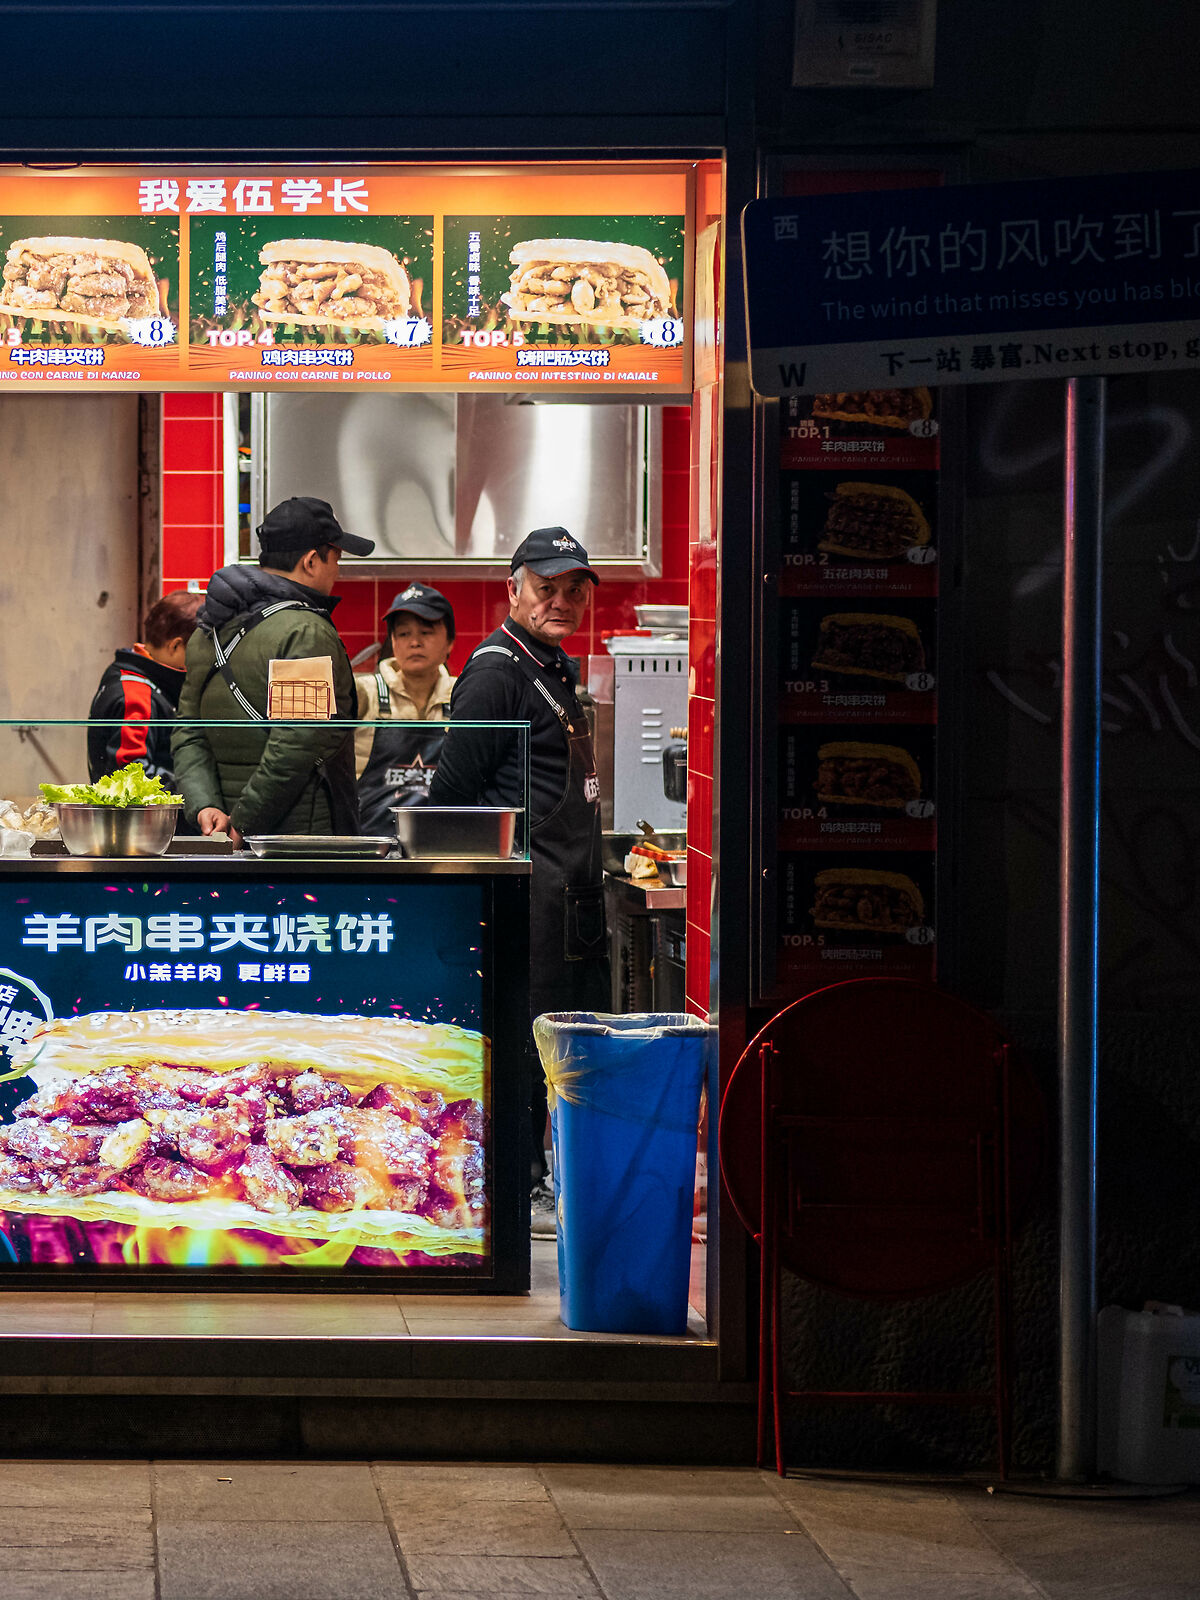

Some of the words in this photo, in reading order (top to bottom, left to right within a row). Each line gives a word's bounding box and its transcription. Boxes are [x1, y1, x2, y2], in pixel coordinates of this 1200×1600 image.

[138, 177, 370, 213] 我爱伍学长
[773, 215, 799, 241] 西
[822, 301, 865, 322] The
[871, 294, 928, 317] wind
[934, 292, 983, 314] that
[989, 290, 1069, 311] misses
[1074, 286, 1117, 312] you
[1123, 281, 1164, 301] has
[10, 349, 105, 366] 牛肉串夹饼
[261, 350, 354, 366] 鸡肉串夹饼
[517, 350, 610, 367] 烤肥肠夹饼
[880, 348, 962, 377] 下一站
[20, 371, 45, 380] CON
[46, 371, 85, 380] CARNE
[87, 371, 99, 380] DI
[101, 371, 141, 380] MANZO
[229, 371, 273, 381] PANINO
[275, 371, 299, 381] CON
[301, 371, 340, 381] CARNE
[342, 371, 355, 381] DI
[357, 371, 392, 381] POLLO
[468, 371, 513, 381] PANINO
[515, 371, 539, 381] CON
[541, 371, 601, 381] INTESTINO
[603, 371, 616, 381] DI
[617, 371, 659, 381] MAIALE
[779, 363, 807, 389] W
[788, 425, 830, 439] TOP.1
[821, 441, 885, 453] 羊肉串夹饼
[22, 913, 395, 954] 羊肉串夹烧饼
[124, 963, 222, 983] 小羔羊肉
[238, 963, 312, 983] 更鲜香
